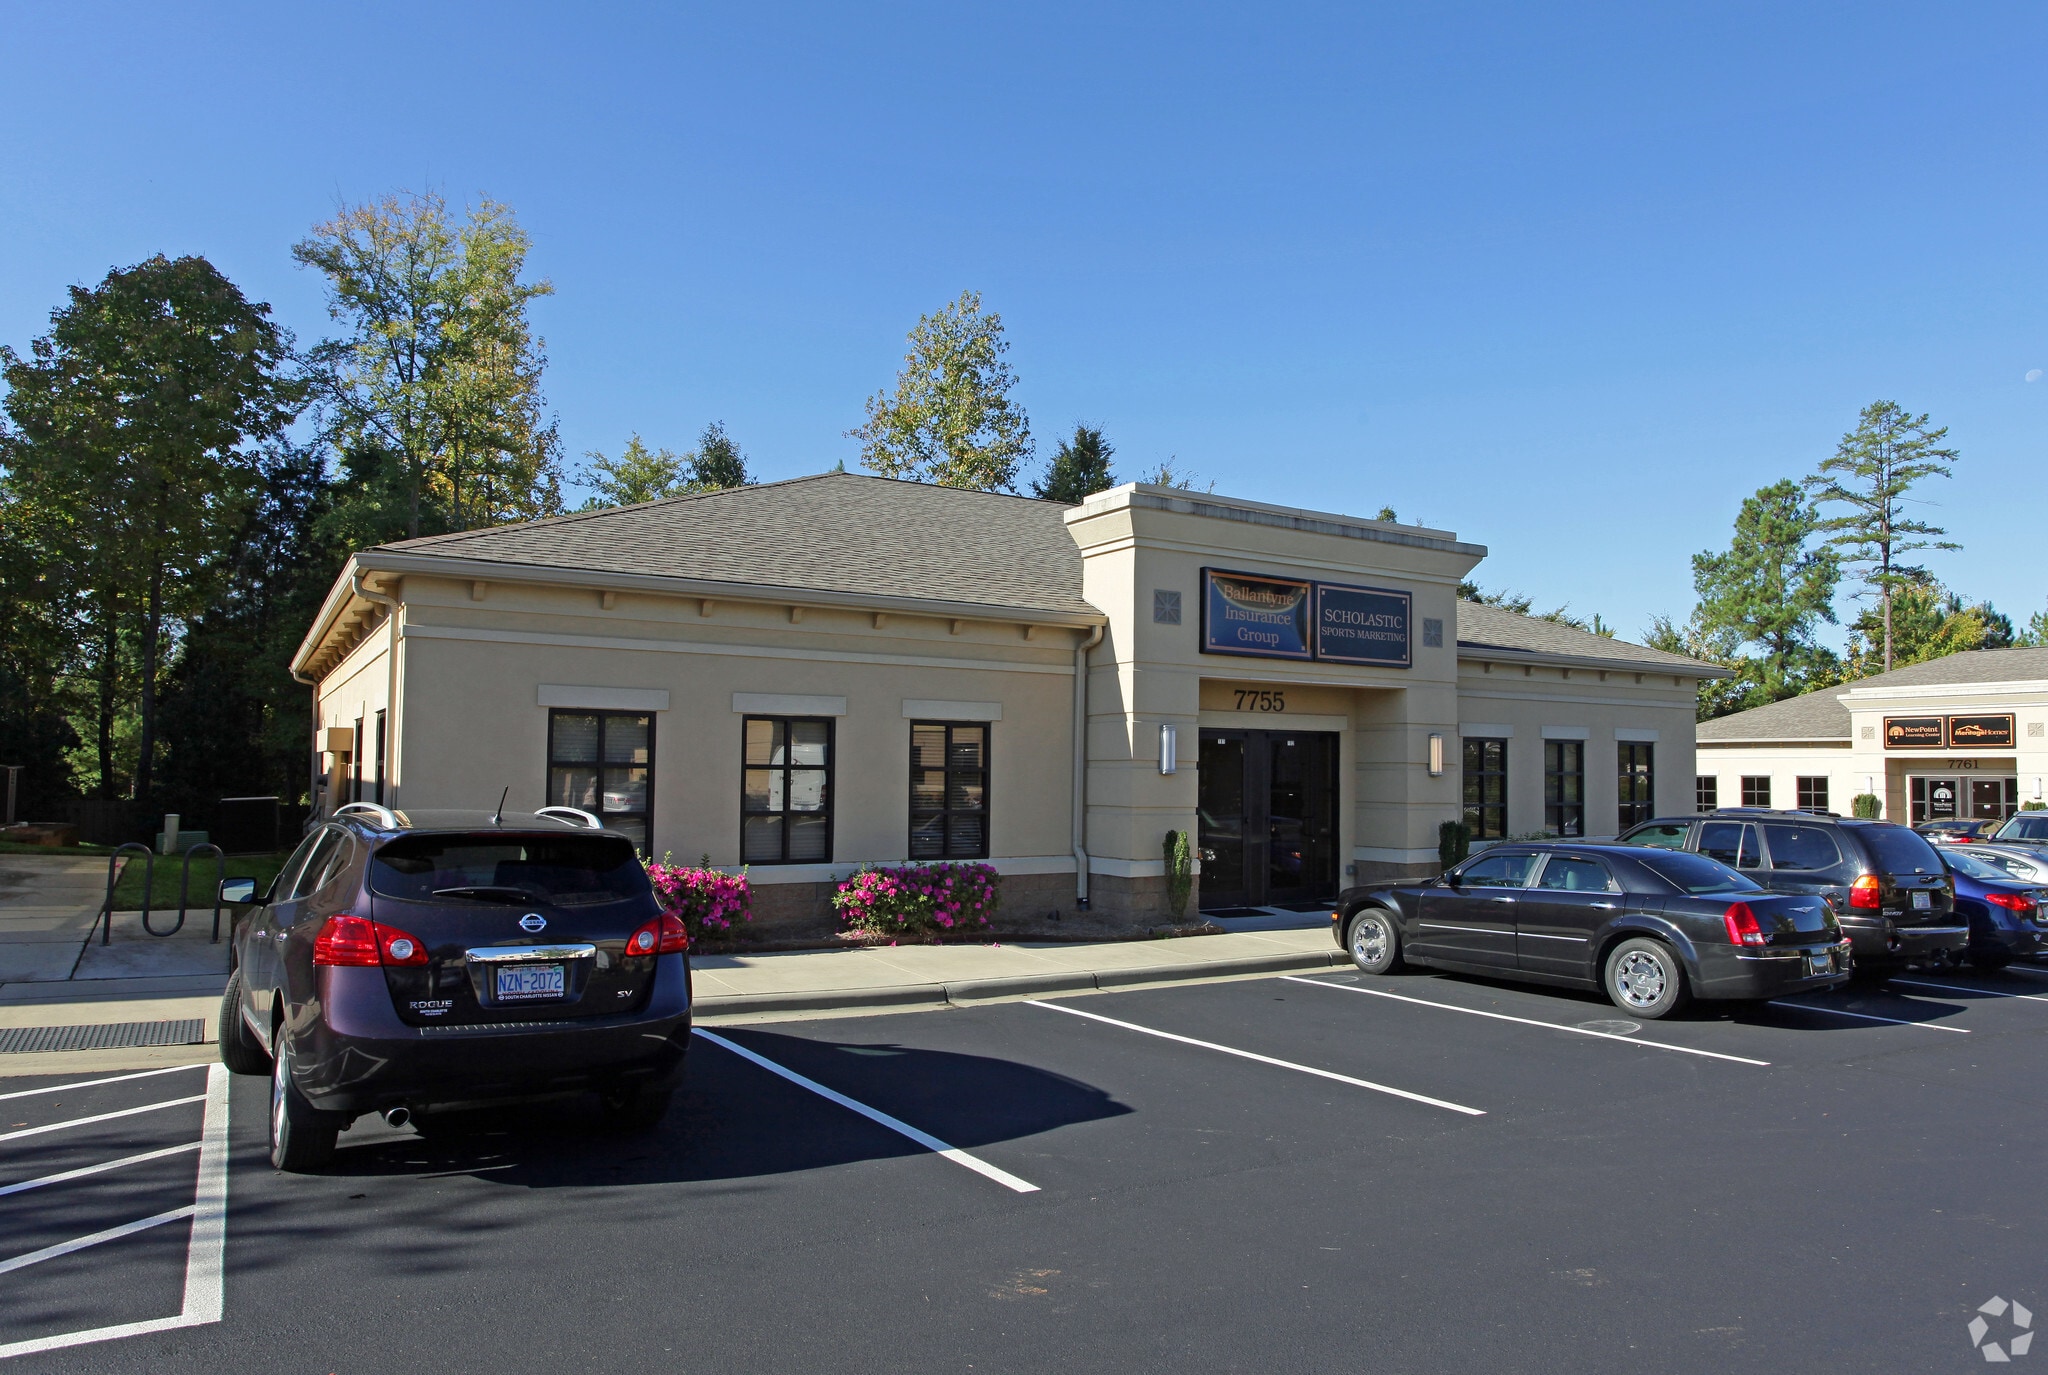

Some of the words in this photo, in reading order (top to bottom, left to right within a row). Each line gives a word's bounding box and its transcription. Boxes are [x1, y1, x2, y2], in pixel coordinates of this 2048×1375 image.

[1223, 584, 1294, 607] Ballantyne
[1225, 605, 1291, 625] Insurance
[1324, 609, 1403, 629] SCHOLASTIC
[1237, 627, 1279, 647] Group
[1321, 626, 1355, 638] SPORTS
[1357, 630, 1406, 643] MARKETING
[1234, 690, 1285, 712] 7755
[1947, 759, 1979, 769] 7761
[498, 972, 562, 992] NZN-2072
[617, 990, 632, 998] SV
[409, 1000, 453, 1009] ROGUE
